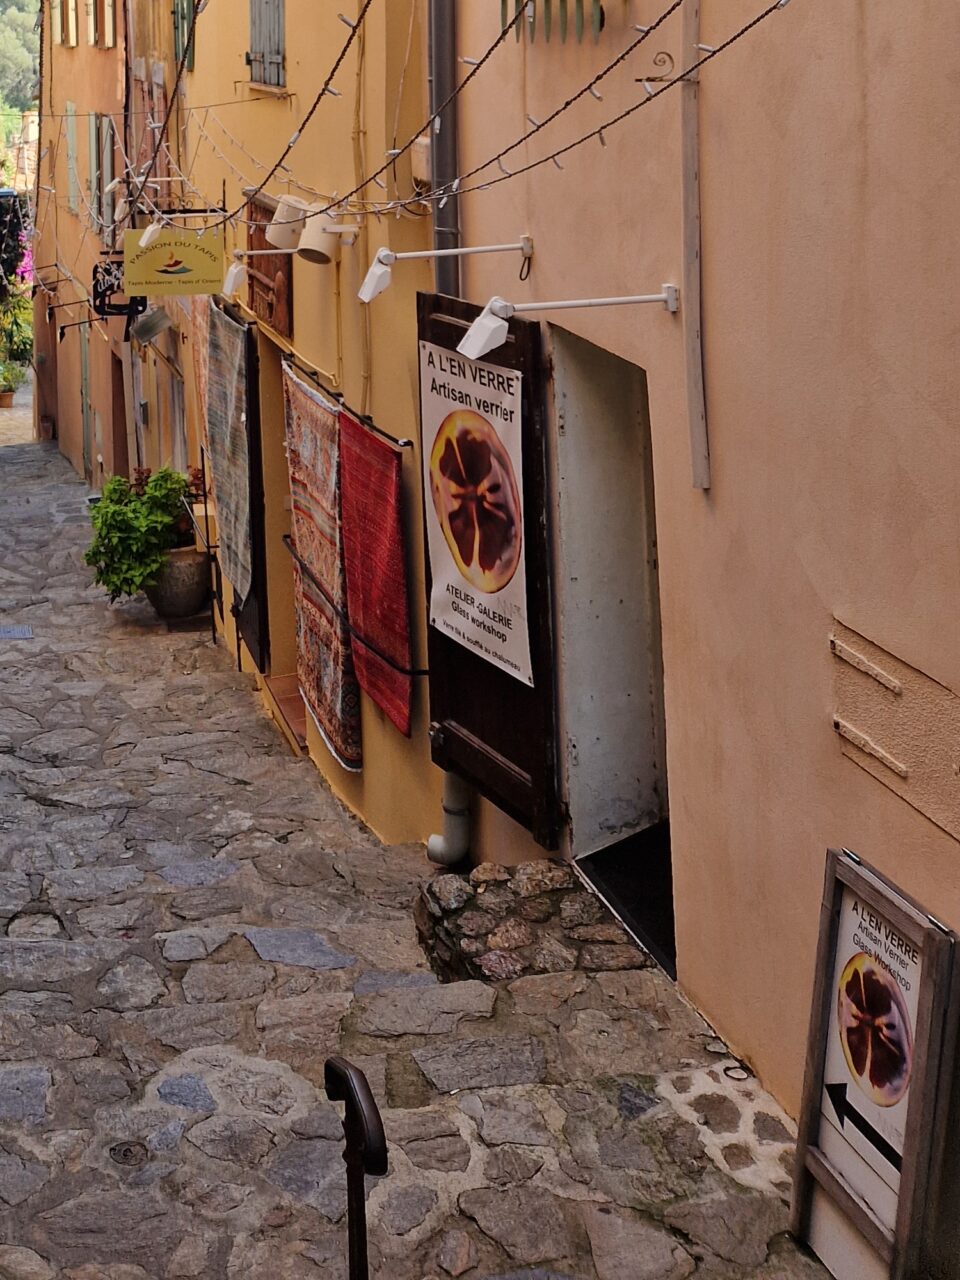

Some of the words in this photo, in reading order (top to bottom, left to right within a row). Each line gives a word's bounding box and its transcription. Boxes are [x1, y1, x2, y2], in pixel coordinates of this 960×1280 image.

[129, 241, 172, 265] PASSION
[193, 244, 218, 263] TAPIS
[427, 350, 436, 369] A
[439, 353, 467, 380] L'EN
[469, 363, 515, 397] VERRE
[430, 376, 472, 408] Artisan
[475, 395, 515, 423] verrier
[446, 583, 475, 609] ATELIER
[451, 600, 470, 621] Glass
[471, 615, 507, 644] workshop
[851, 900, 859, 916] A
[861, 906, 883, 934] L'EN
[884, 925, 919, 966] VERRE
[858, 921, 882, 948] Artisan
[884, 942, 910, 971] Verrier
[852, 933, 873, 958] Glass
[874, 951, 911, 992] Workshop
